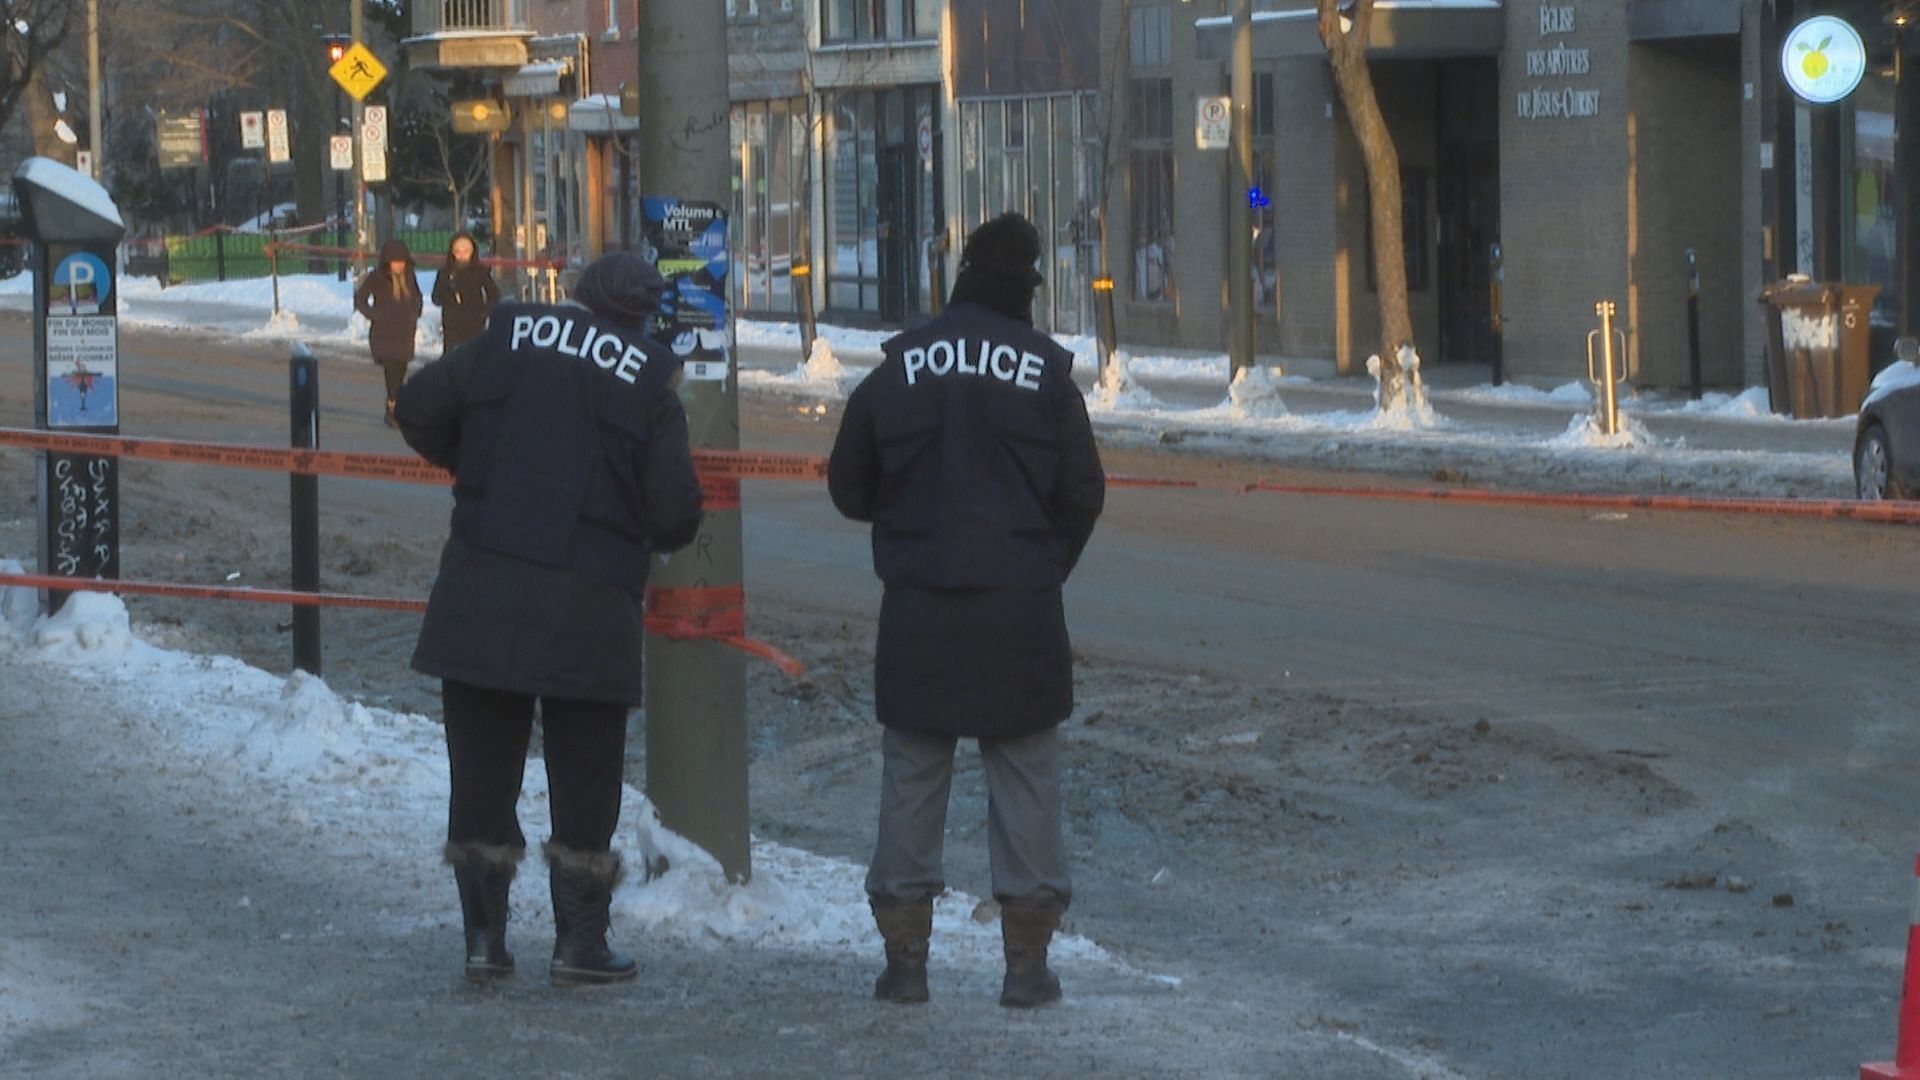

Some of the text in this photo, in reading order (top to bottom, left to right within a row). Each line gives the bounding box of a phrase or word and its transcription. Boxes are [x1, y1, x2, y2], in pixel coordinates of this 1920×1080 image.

[1527, 41, 1590, 76] DES APÔTRES
[1518, 84, 1600, 119] DE JÉSUS-CHRIST
[663, 218, 693, 231] MTL
[664, 204, 714, 218] Volume
[69, 261, 95, 306] P
[48, 319, 114, 327] FIN DU MONDE
[53, 328, 110, 336] FIN DU MOIS
[511, 315, 649, 384] POLICE
[904, 340, 1045, 390] POLICE
